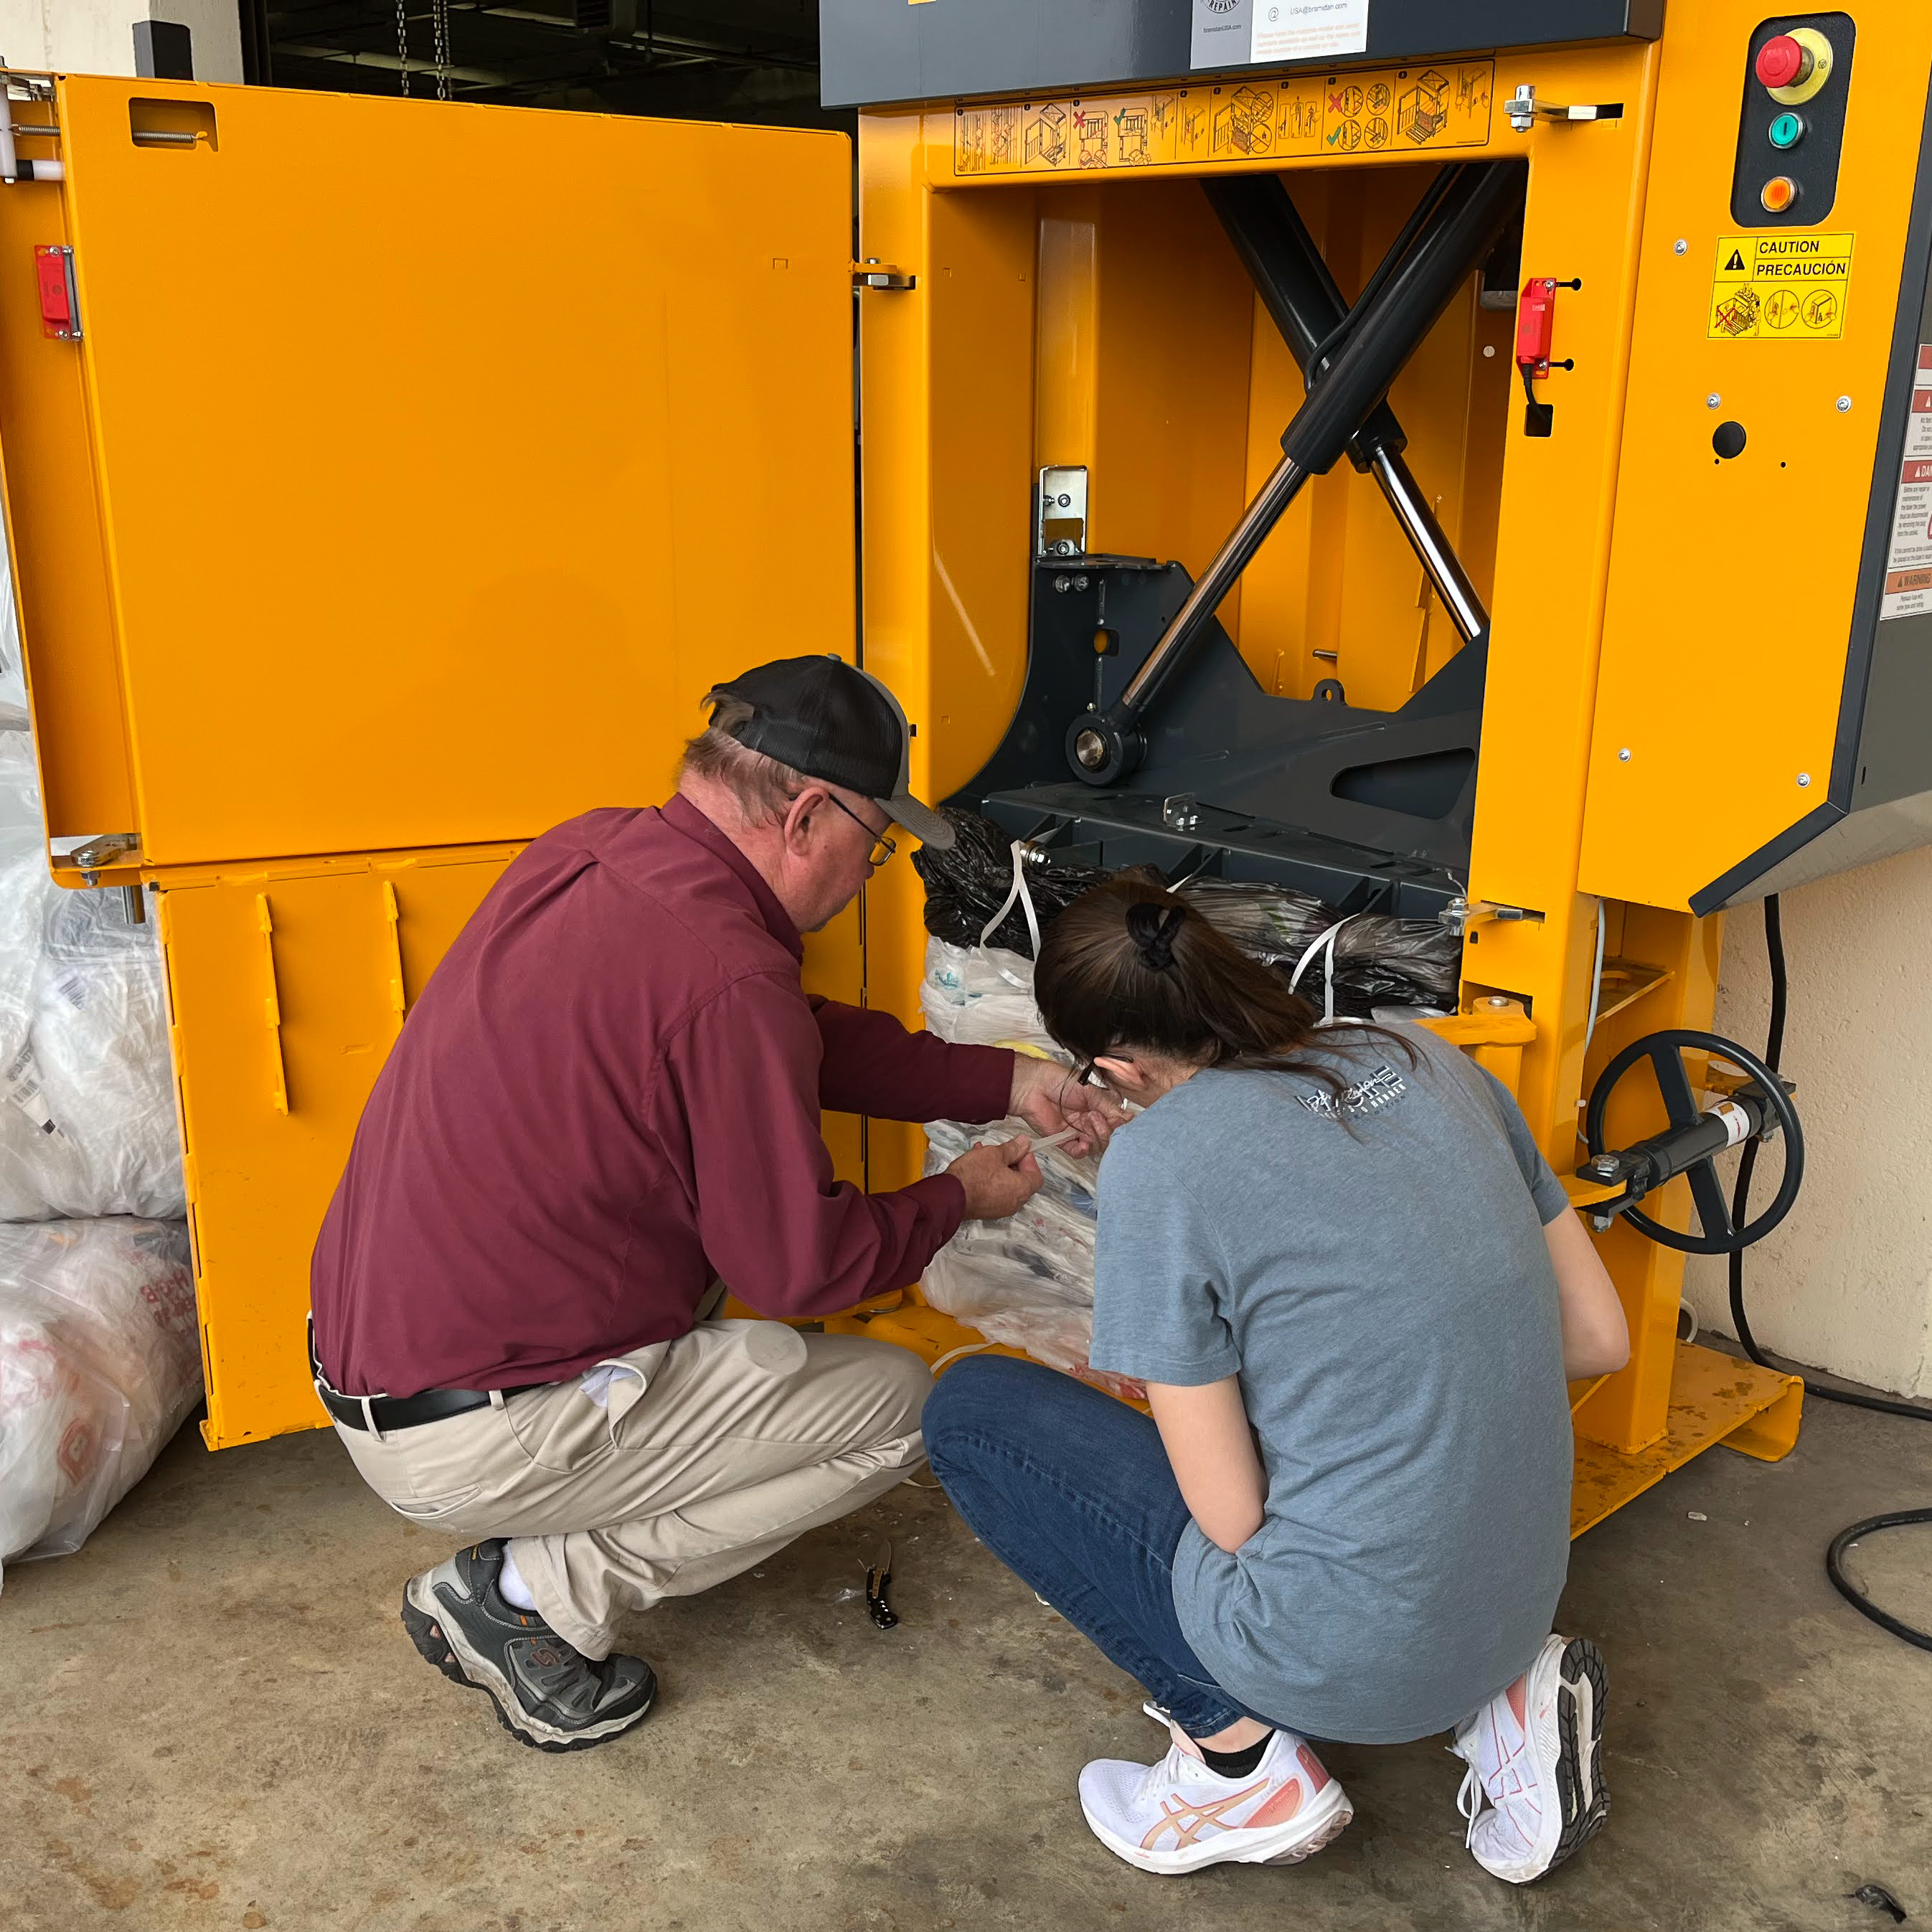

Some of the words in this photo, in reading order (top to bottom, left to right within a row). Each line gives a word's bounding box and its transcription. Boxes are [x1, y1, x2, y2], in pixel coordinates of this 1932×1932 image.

[1760, 240, 1819, 254] CAUTION
[1756, 260, 1847, 276] PRECAUCIÓN
[1905, 573, 1931, 586] WARNING
